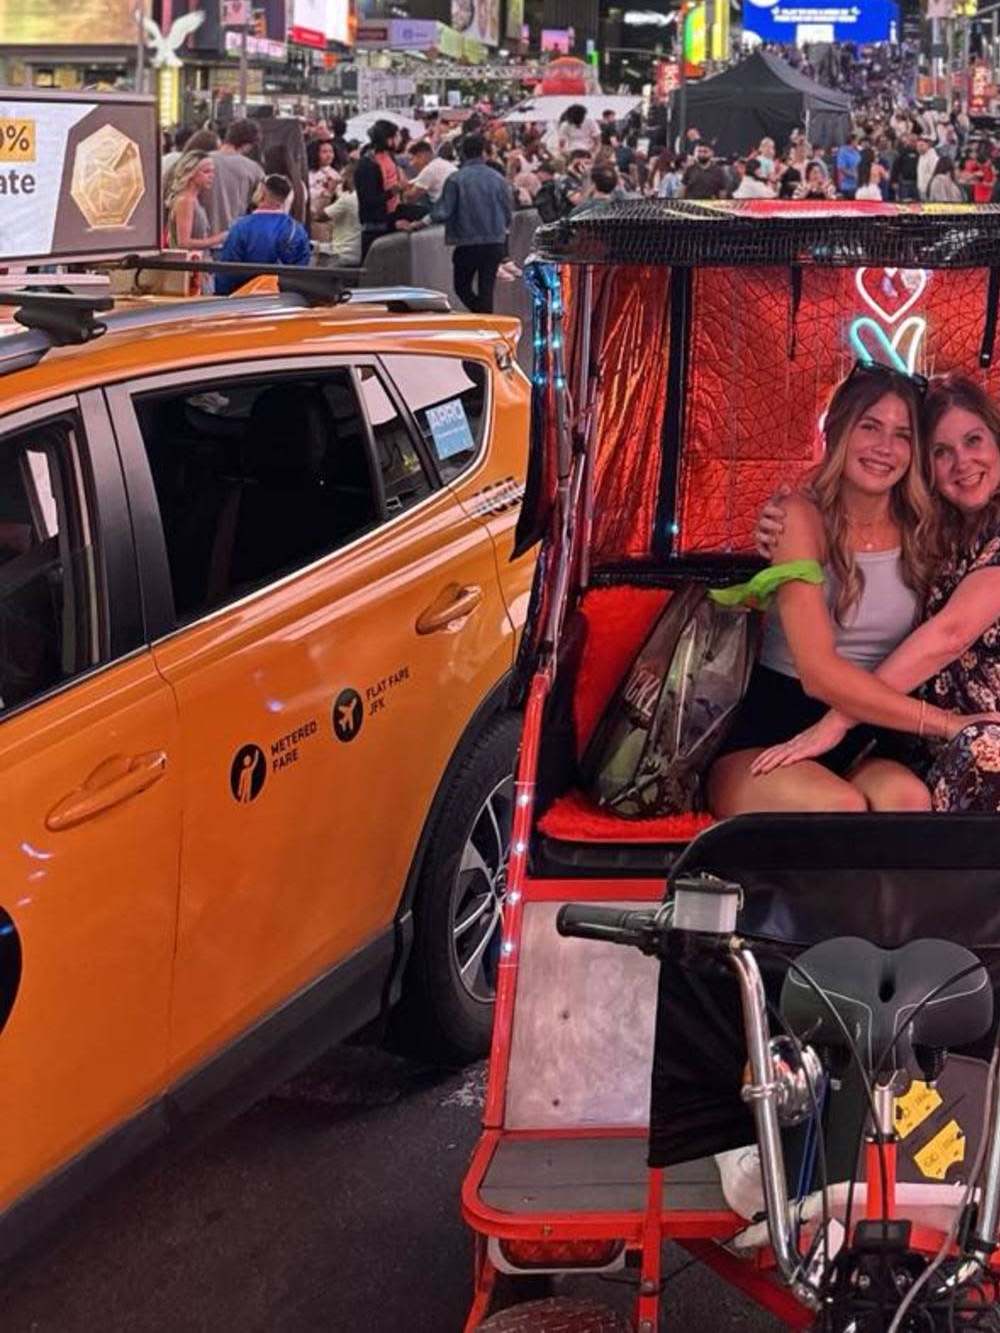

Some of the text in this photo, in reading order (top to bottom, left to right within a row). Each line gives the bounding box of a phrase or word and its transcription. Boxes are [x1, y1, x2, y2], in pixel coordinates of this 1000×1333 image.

[365, 667, 410, 702] FLAT FARE
[368, 697, 386, 717] JFK
[271, 720, 318, 757] METERED
[272, 749, 300, 773] FARE
